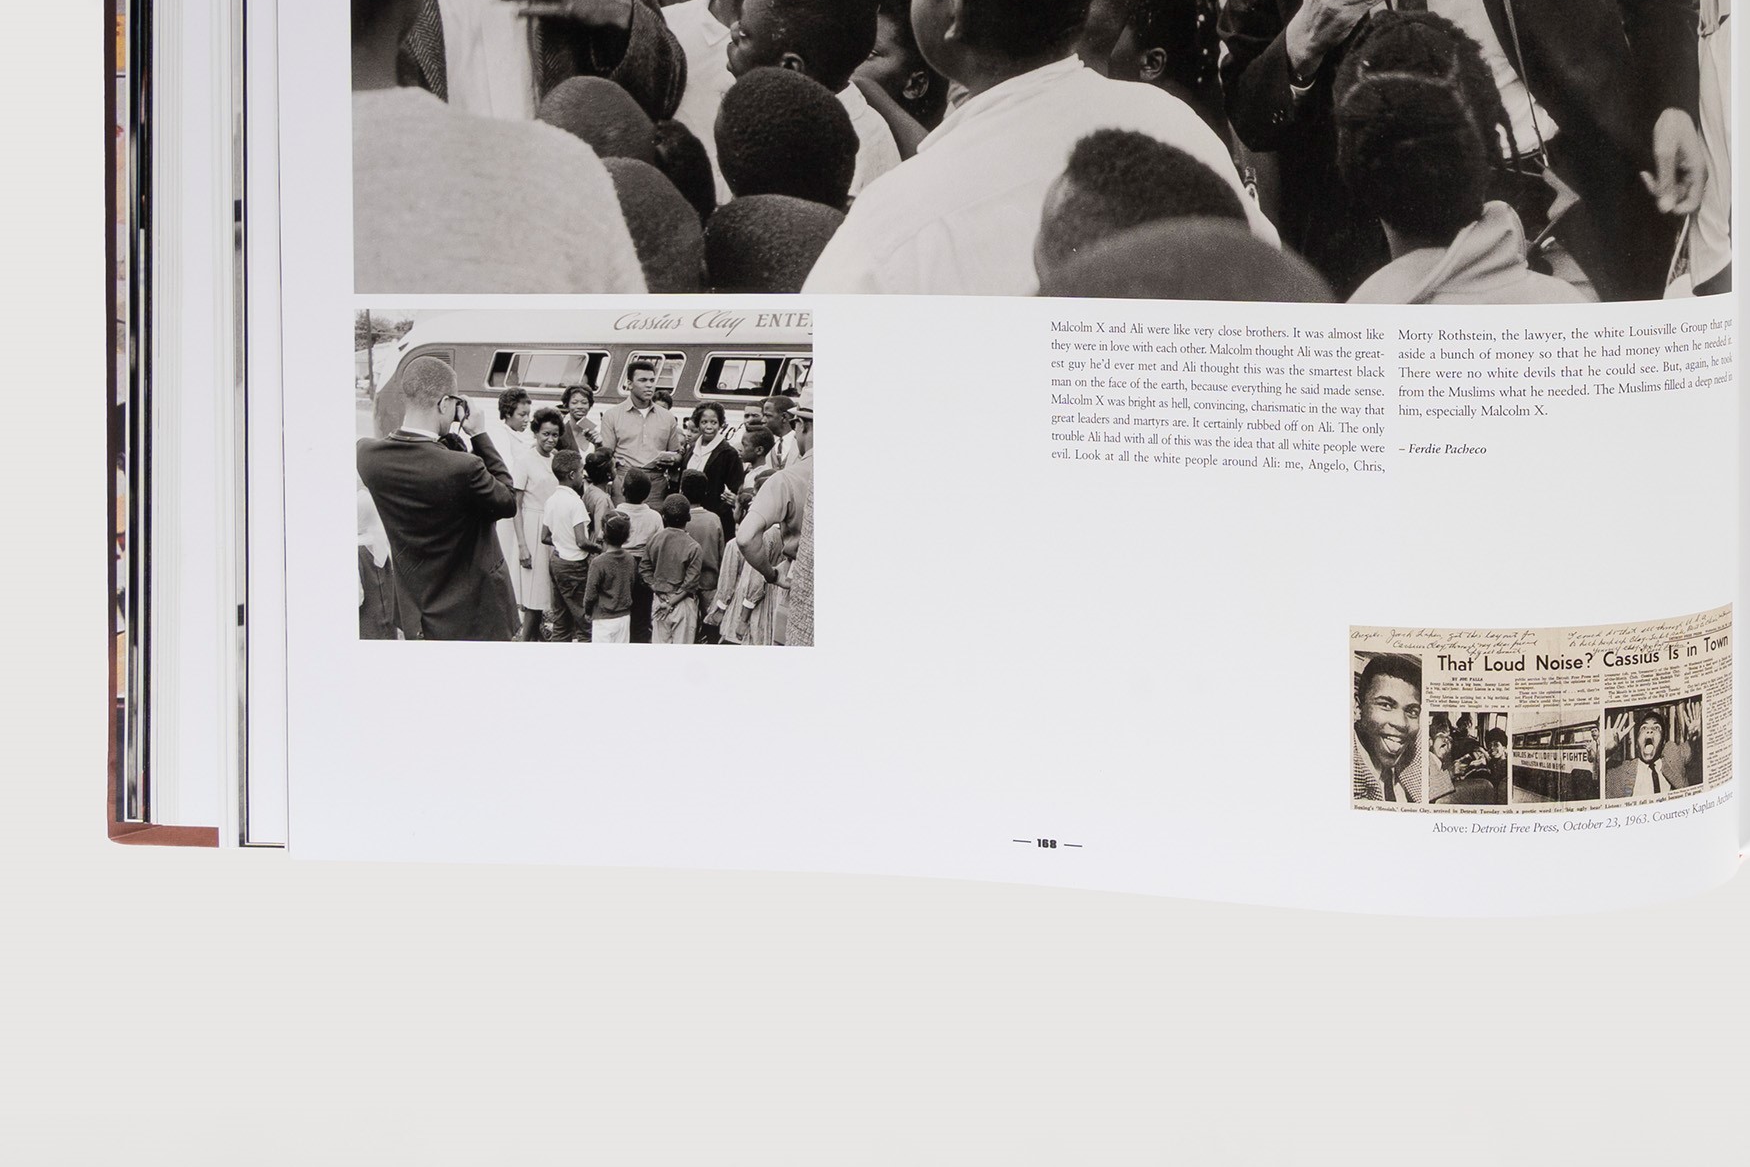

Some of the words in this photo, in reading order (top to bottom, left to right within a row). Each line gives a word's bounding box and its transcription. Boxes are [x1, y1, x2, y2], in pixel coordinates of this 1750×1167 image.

[613, 311, 684, 331] Cassius
[692, 309, 746, 337] Clay
[755, 313, 813, 328] ENTE
[1050, 320, 1093, 333] Malcolm
[1096, 322, 1105, 333] X
[1108, 322, 1126, 334] and
[1129, 322, 1144, 334] Ali
[1146, 326, 1170, 335] were
[1173, 323, 1191, 336] like
[1193, 328, 1215, 339] very
[1218, 324, 1242, 337] close
[1245, 325, 1289, 338] brothers.
[1293, 327, 1301, 338] It
[1304, 330, 1324, 339] was
[1327, 327, 1362, 340] almost
[1366, 328, 1385, 340] like
[1398, 329, 1434, 344] Morty
[1438, 329, 1497, 343] Rothstein,
[1501, 328, 1520, 341] the
[1524, 328, 1566, 343] lawyer,
[1571, 327, 1589, 340] the
[1594, 326, 1625, 338] white
[1629, 323, 1677, 337] Louisville
[1680, 322, 1708, 334] Group
[1398, 404, 1423, 418] him,
[1425, 404, 1477, 419] especially
[1481, 404, 1530, 416] Malcolm
[1534, 404, 1548, 416] X.
[1408, 443, 1442, 454] Ferdie
[1444, 443, 1487, 455] Pacheco
[1437, 655, 1474, 671] That
[1484, 655, 1525, 671] Loud
[1536, 652, 1594, 670] Noise?
[1603, 649, 1660, 667] Cassius
[1668, 645, 1679, 660] Is
[1686, 642, 1697, 657] in
[1703, 635, 1729, 652] Town
[1432, 822, 1468, 834] Above:
[1471, 823, 1507, 834] Detroit
[1509, 822, 1531, 833] Free
[1533, 822, 1560, 834] Press,
[1563, 818, 1604, 832] October
[1605, 817, 1621, 829] 23,
[1625, 813, 1650, 826] 1963.
[1652, 808, 1690, 822] Courtesy
[1692, 799, 1715, 814] Kaplan
[1036, 838, 1057, 849] 168
